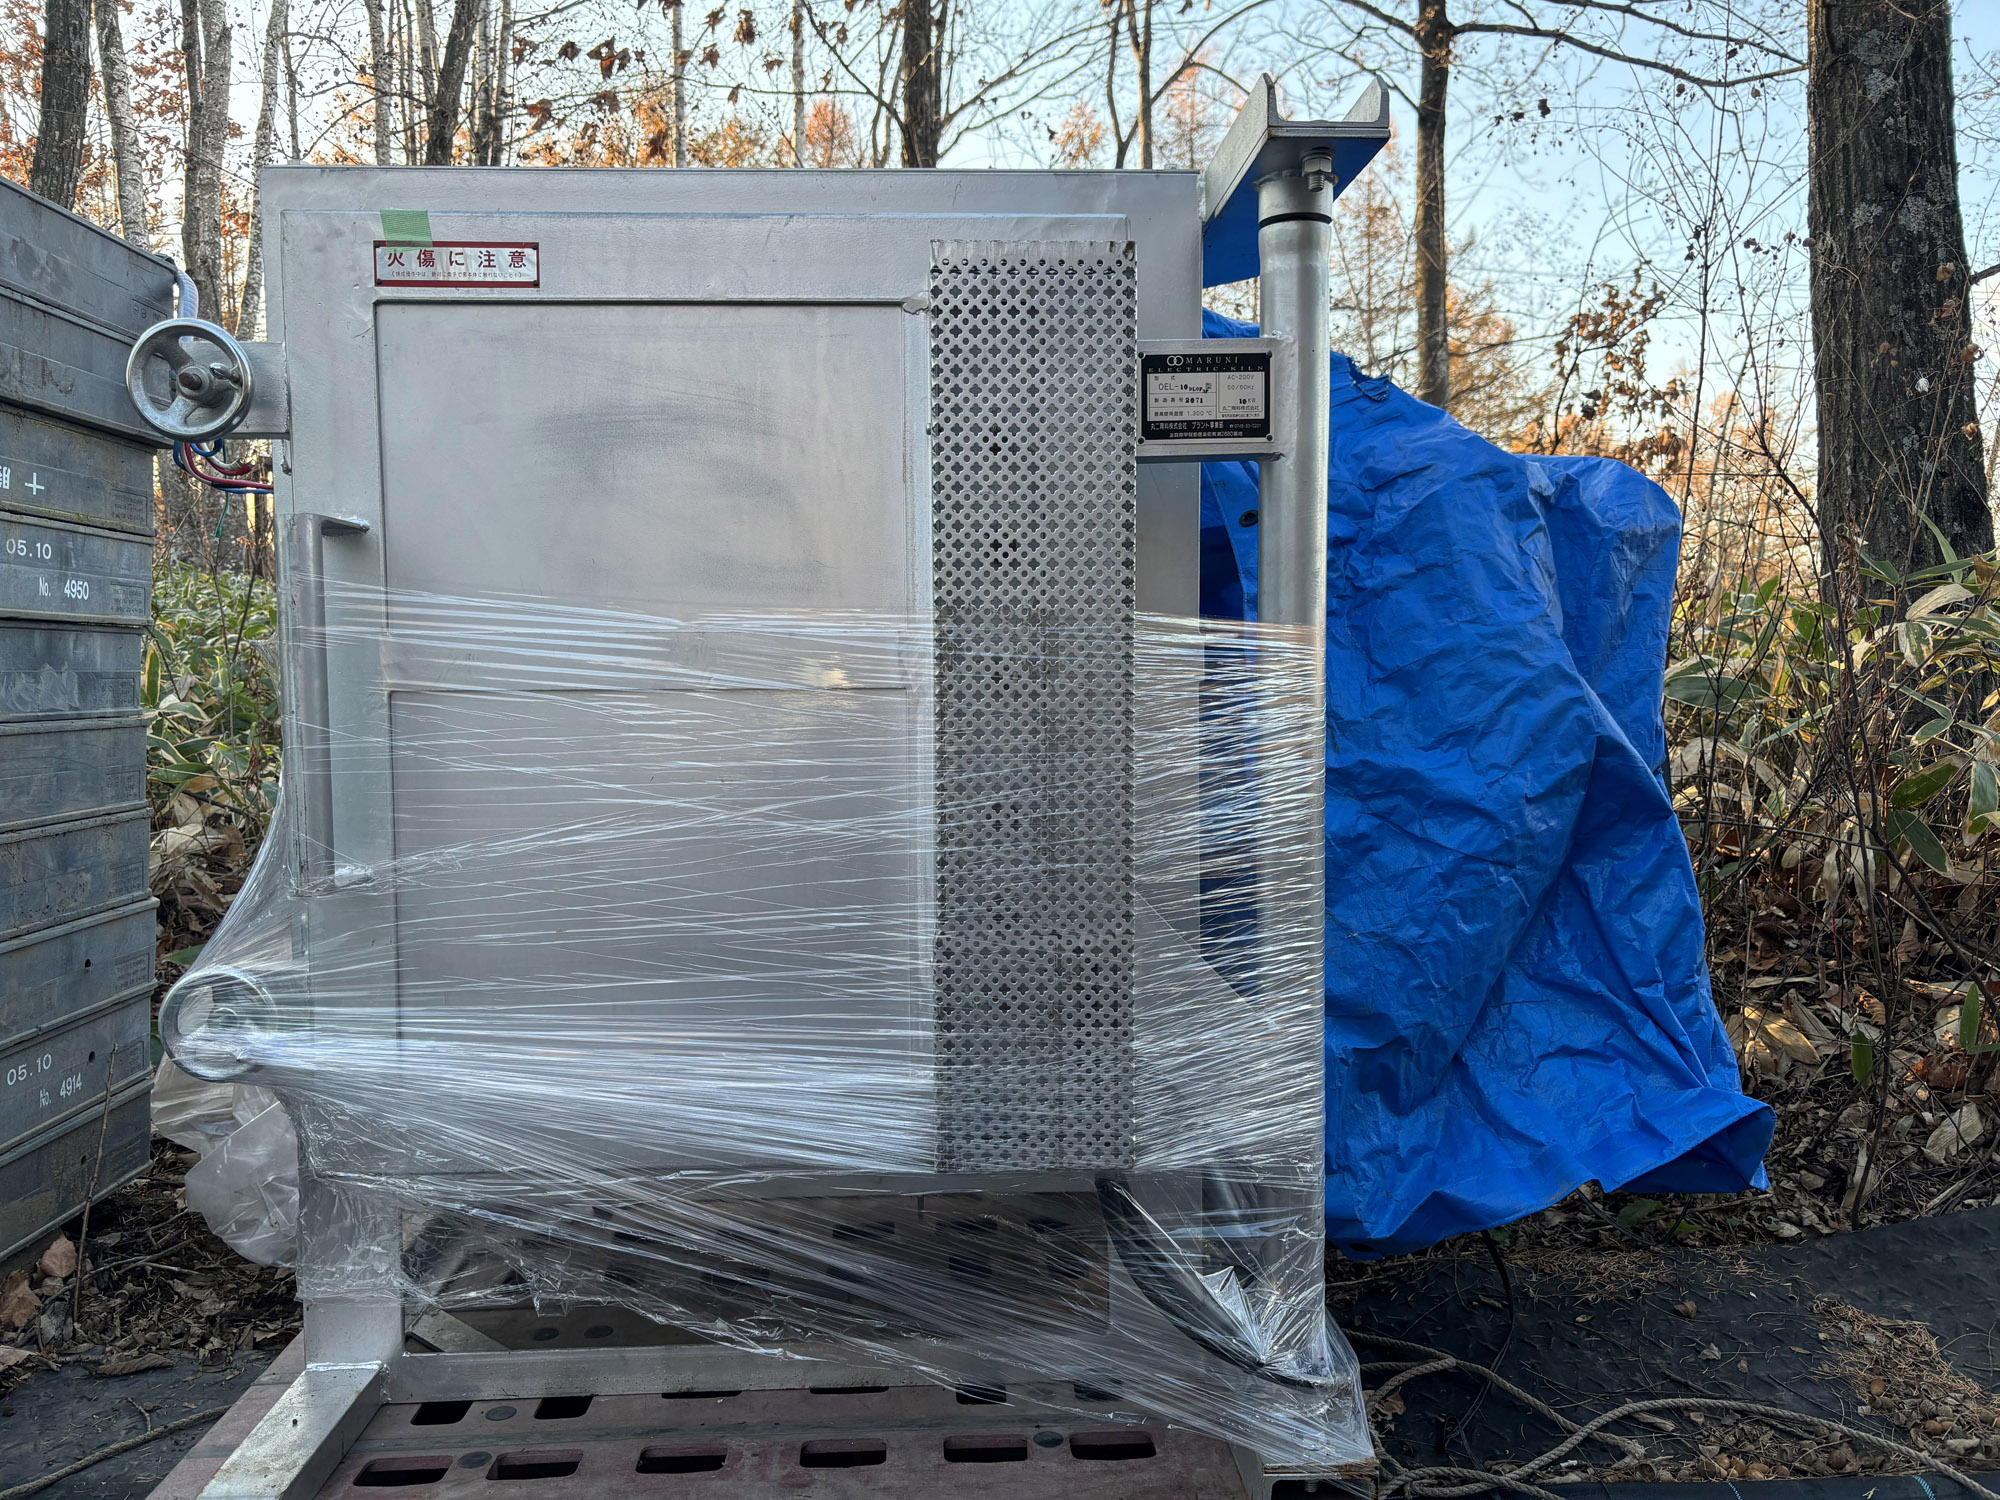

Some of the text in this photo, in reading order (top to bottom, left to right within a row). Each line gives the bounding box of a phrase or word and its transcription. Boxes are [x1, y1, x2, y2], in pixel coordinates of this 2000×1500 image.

[387, 249, 527, 268] 火傷に注意
[1185, 356, 1238, 364] MARUNI
[6, 538, 52, 560] 05.10
[39, 577, 89, 600] No. 4950
[7, 1053, 52, 1086] 05.10
[39, 1072, 82, 1109] No. 4914
